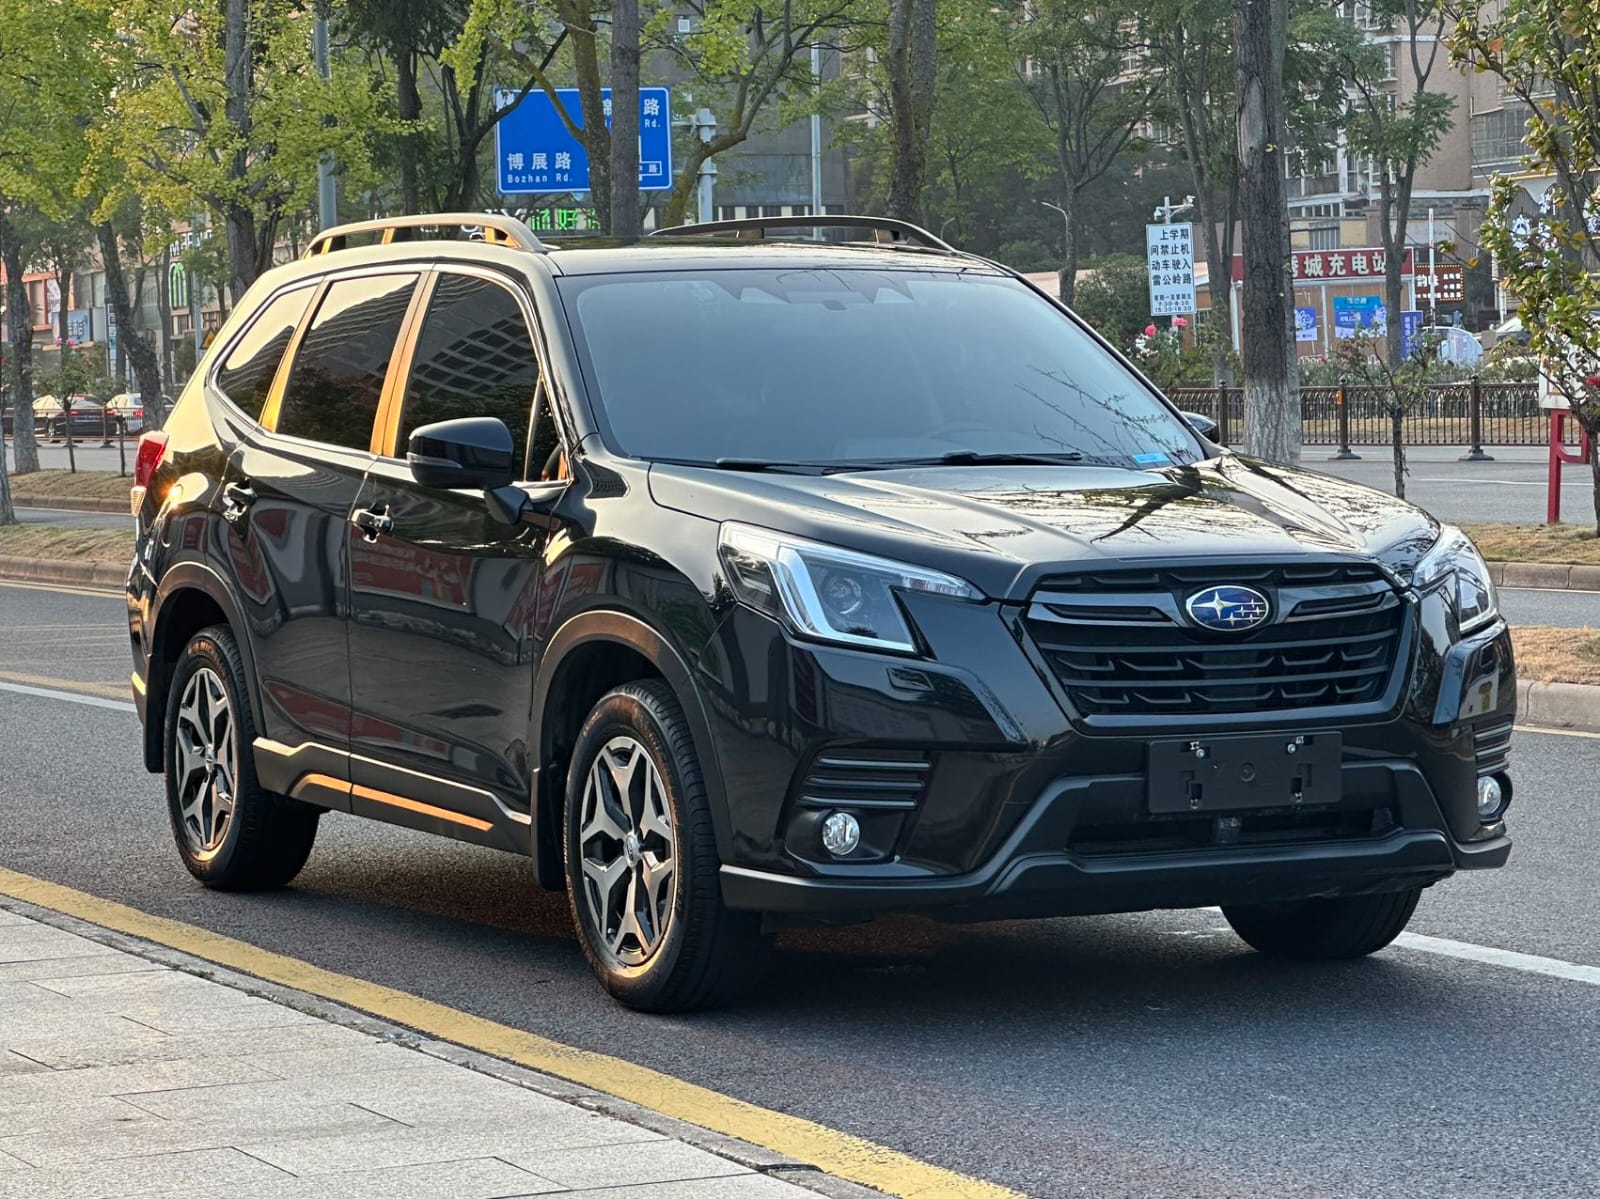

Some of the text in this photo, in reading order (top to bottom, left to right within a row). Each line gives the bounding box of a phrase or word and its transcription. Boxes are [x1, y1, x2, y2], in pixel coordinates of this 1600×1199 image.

[507, 152, 572, 171] 博展路
[507, 172, 574, 184] Bozhan Rd.
[1160, 228, 1189, 240] 上学期
[1151, 244, 1190, 256] 间禁止机
[1152, 259, 1191, 271] 动车驶入
